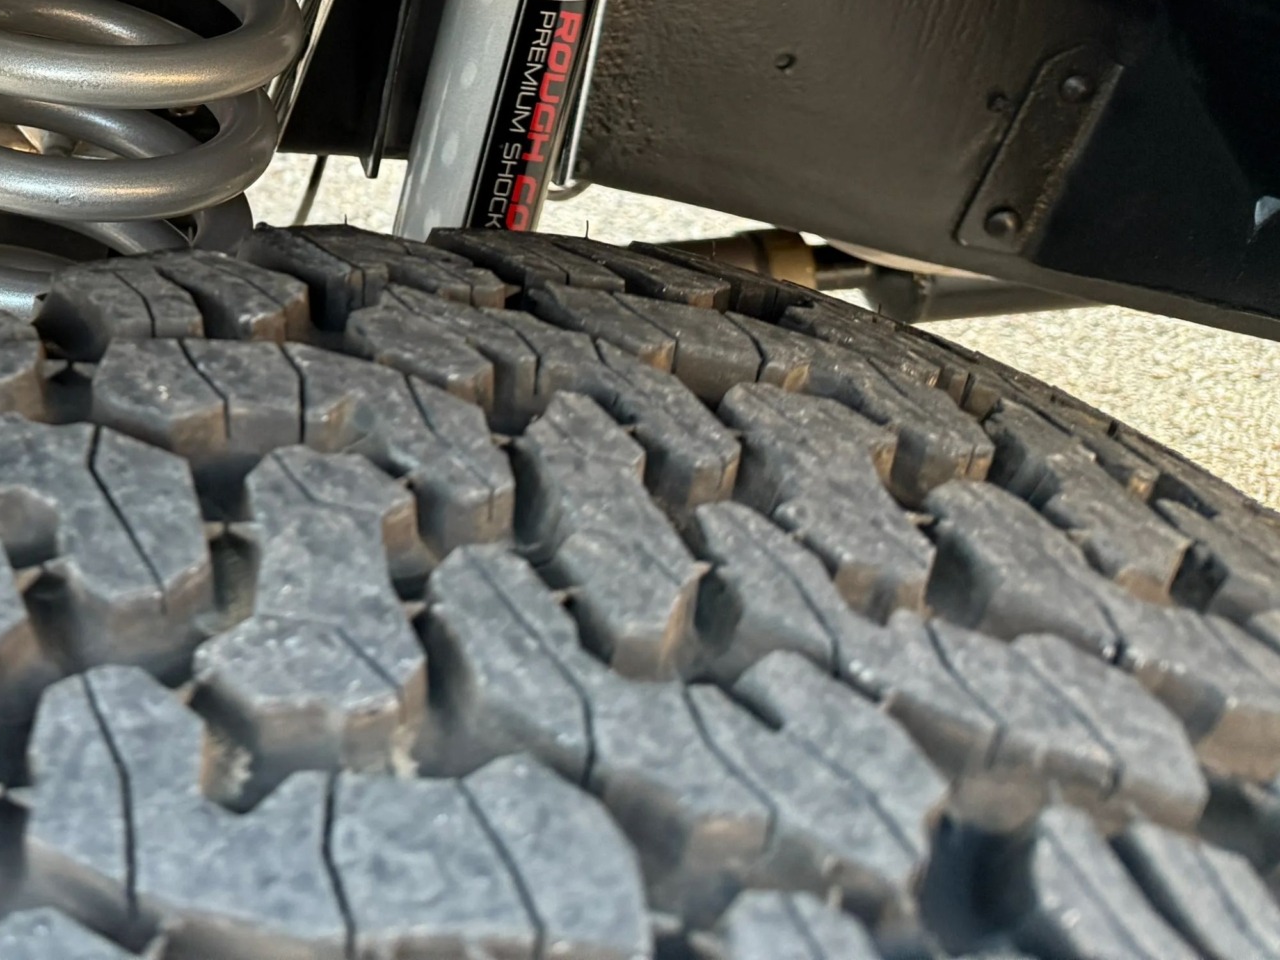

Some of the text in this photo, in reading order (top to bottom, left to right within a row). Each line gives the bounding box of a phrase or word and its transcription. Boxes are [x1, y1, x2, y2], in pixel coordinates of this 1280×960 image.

[485, 11, 557, 228] PREMIUM SHOCK
[522, 11, 583, 162] ROUGH
